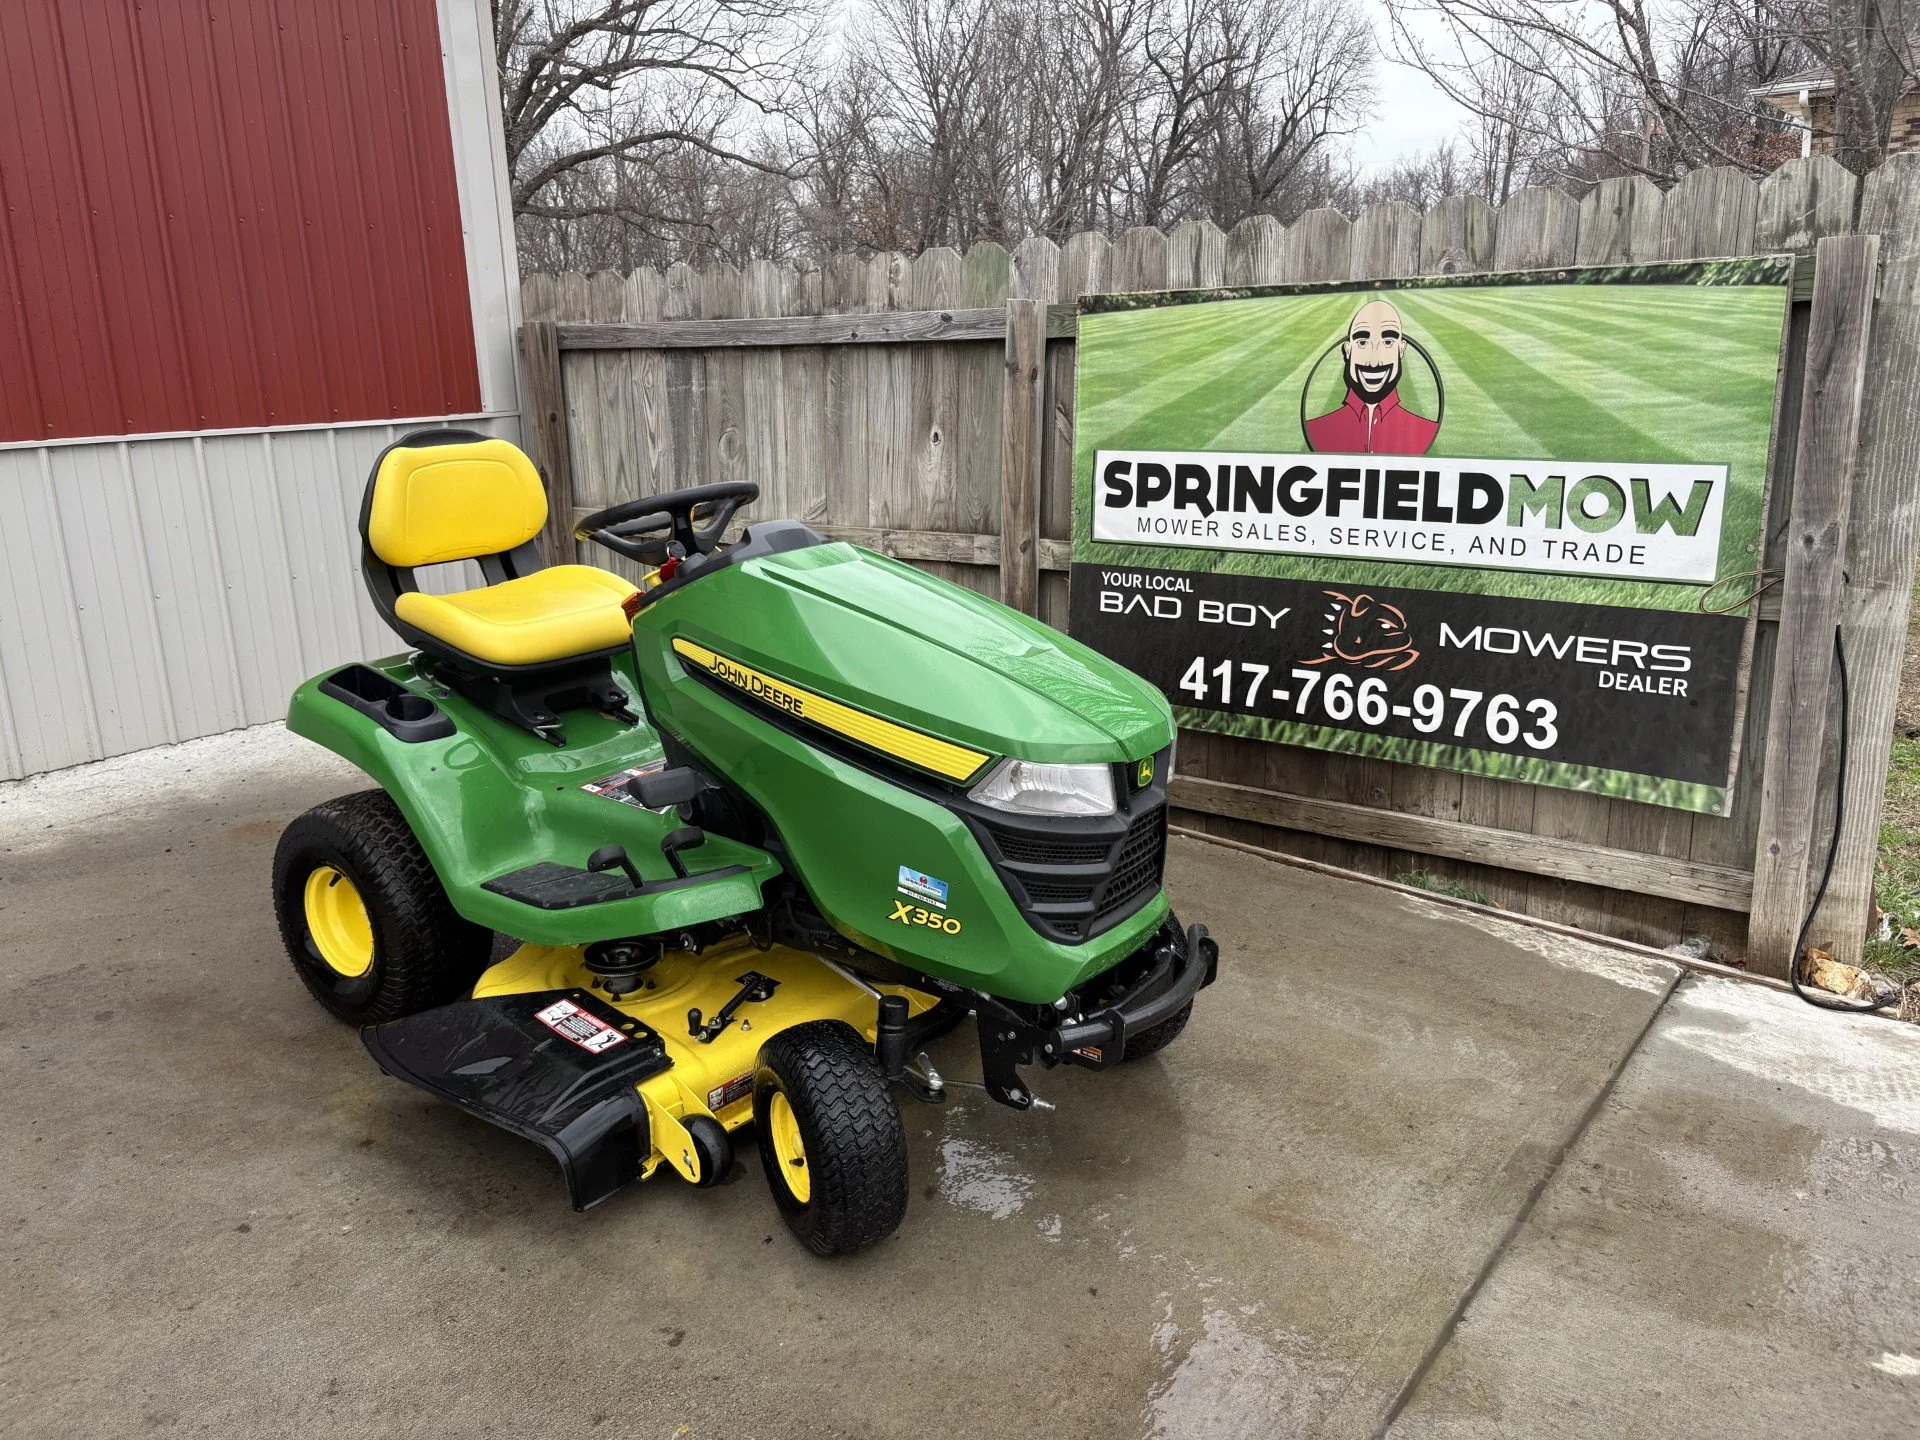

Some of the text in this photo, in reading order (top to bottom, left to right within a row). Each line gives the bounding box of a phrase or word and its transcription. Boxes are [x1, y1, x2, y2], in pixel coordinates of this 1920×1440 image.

[1103, 460, 1713, 536] SPRINGFIELDMOW
[1136, 516, 1646, 565] MOWER SALES, SERVICE, AND TRADE
[1101, 571, 1194, 594] YOUR LOCAL
[1099, 591, 1292, 629] BAD BOY
[1439, 622, 1692, 672] MOWERS
[709, 655, 804, 716] JOHN DEERE
[1179, 655, 1560, 751] 417-766-9763
[1598, 670, 1688, 698] DEALER
[886, 899, 961, 935] X350
